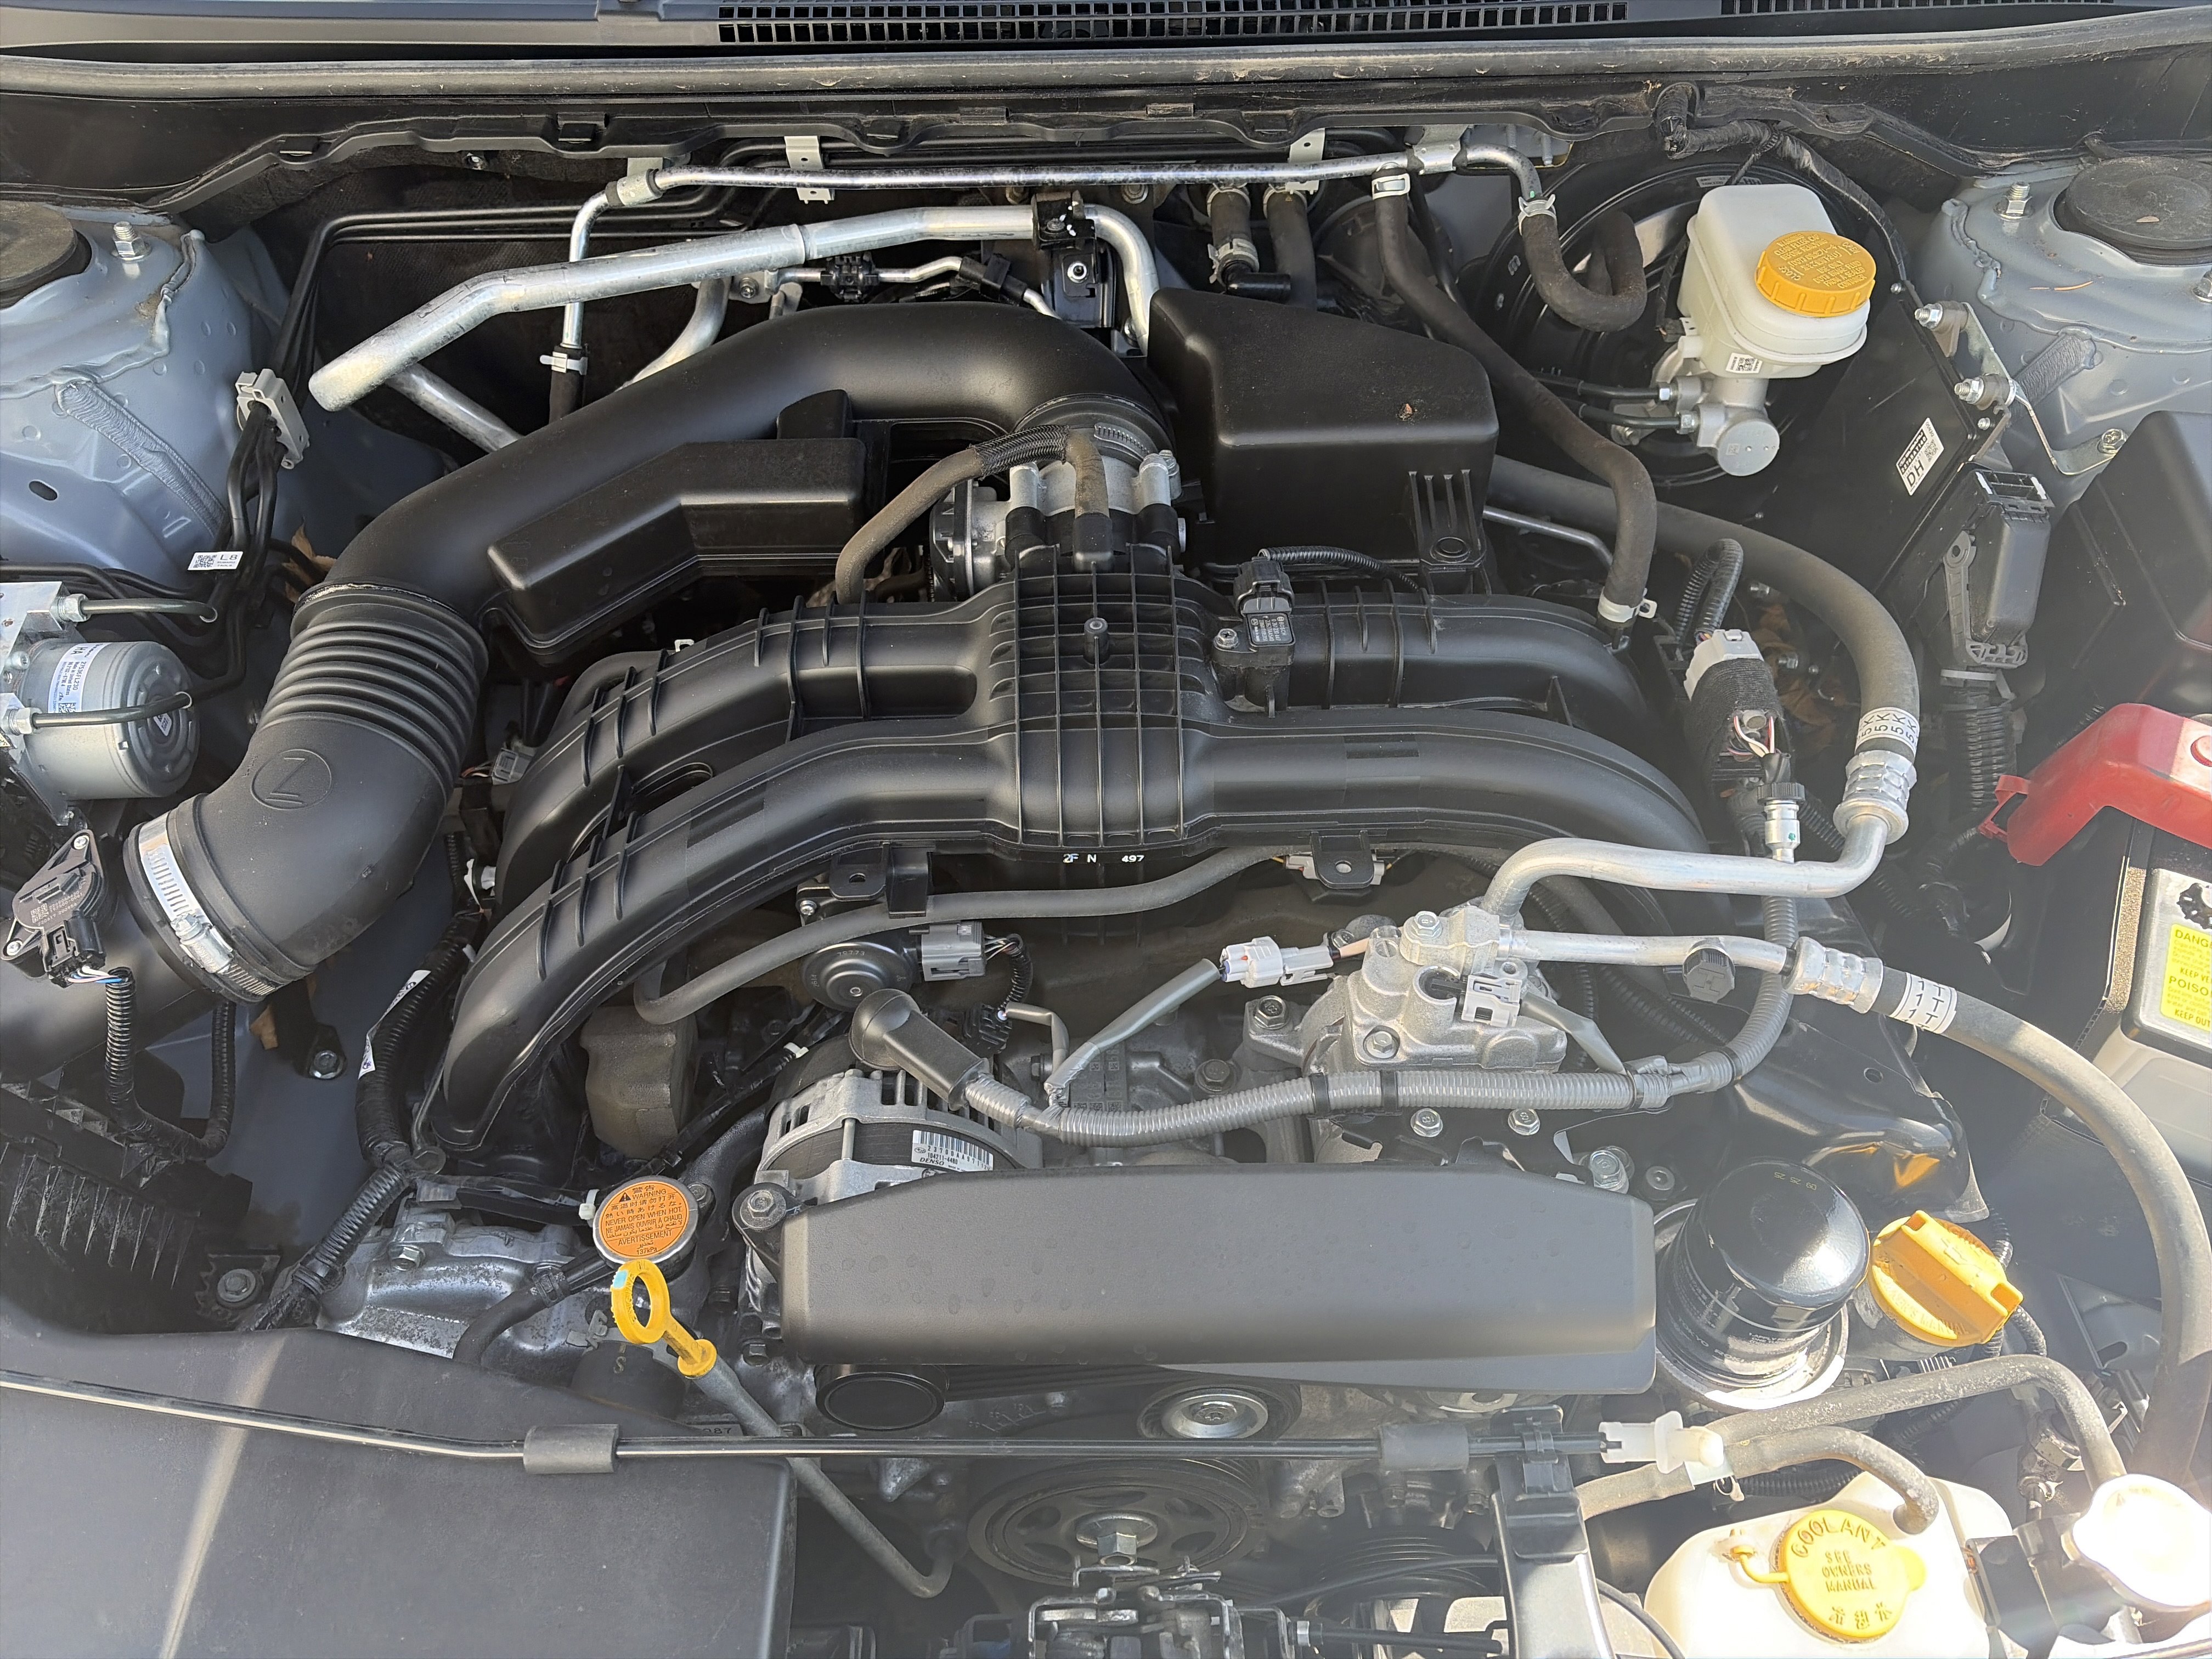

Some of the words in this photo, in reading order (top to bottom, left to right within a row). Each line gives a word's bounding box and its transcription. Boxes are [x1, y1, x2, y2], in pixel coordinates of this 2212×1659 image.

[1842, 242, 1861, 253] OPEN
[1778, 265, 1801, 281] CLOSE
[1907, 460, 1925, 488] DH
[70, 646, 86, 655] HA
[1063, 853, 1079, 863] 2F
[1087, 854, 1097, 863] N
[1121, 855, 1145, 863] 497
[2180, 967, 2199, 978] KEEP
[2169, 975, 2212, 996] POISO
[2174, 1009, 2194, 1020] KEEP
[919, 1157, 945, 1166] DENSO
[633, 1189, 667, 1200] WARNING
[606, 1216, 626, 1227] NEVER
[628, 1213, 645, 1222] OPEN
[647, 1209, 667, 1218] WHEN
[614, 1222, 634, 1232] JAMAIS
[636, 1218, 656, 1228] OUVRIR
[618, 1229, 673, 1246] AVERTISSEMENT
[636, 1247, 658, 1256] 137kPa
[1791, 1516, 1888, 1558] COOLANT
[1825, 1550, 1852, 1564] SEE
[1821, 1562, 1872, 1578] OWNERS
[1825, 1577, 1876, 1593] MANUAL
